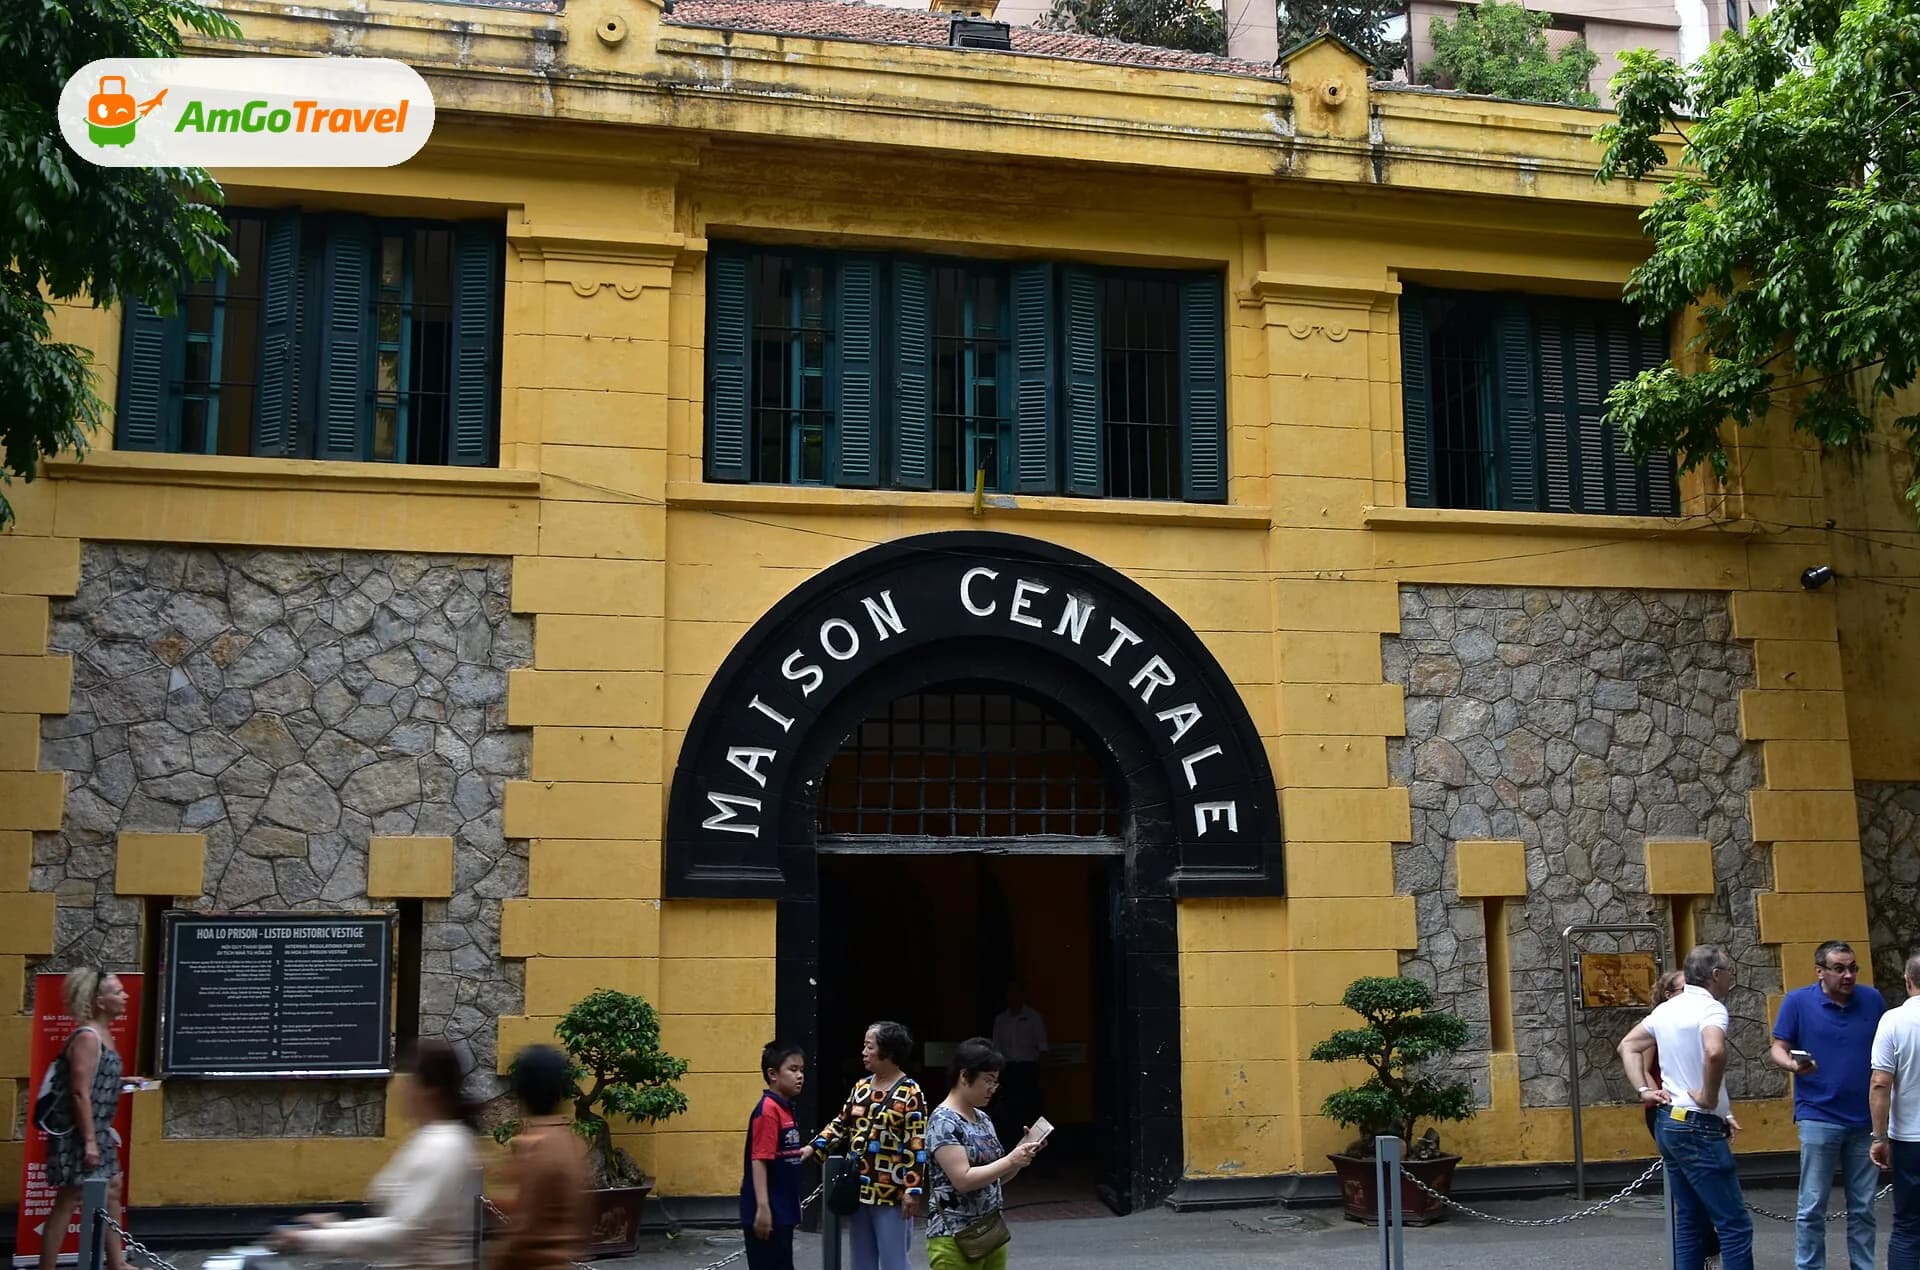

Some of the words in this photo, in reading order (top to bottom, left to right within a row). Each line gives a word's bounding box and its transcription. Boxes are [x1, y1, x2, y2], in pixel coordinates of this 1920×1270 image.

[702, 590, 907, 838] MAISON
[959, 567, 1238, 838] CENTRALE
[196, 928, 214, 939] HOA
[216, 928, 226, 939] LO
[227, 928, 258, 939] PRISON
[264, 928, 291, 939] LISTED
[293, 927, 330, 938] HISTORIC
[331, 927, 364, 938] VESTIGE
